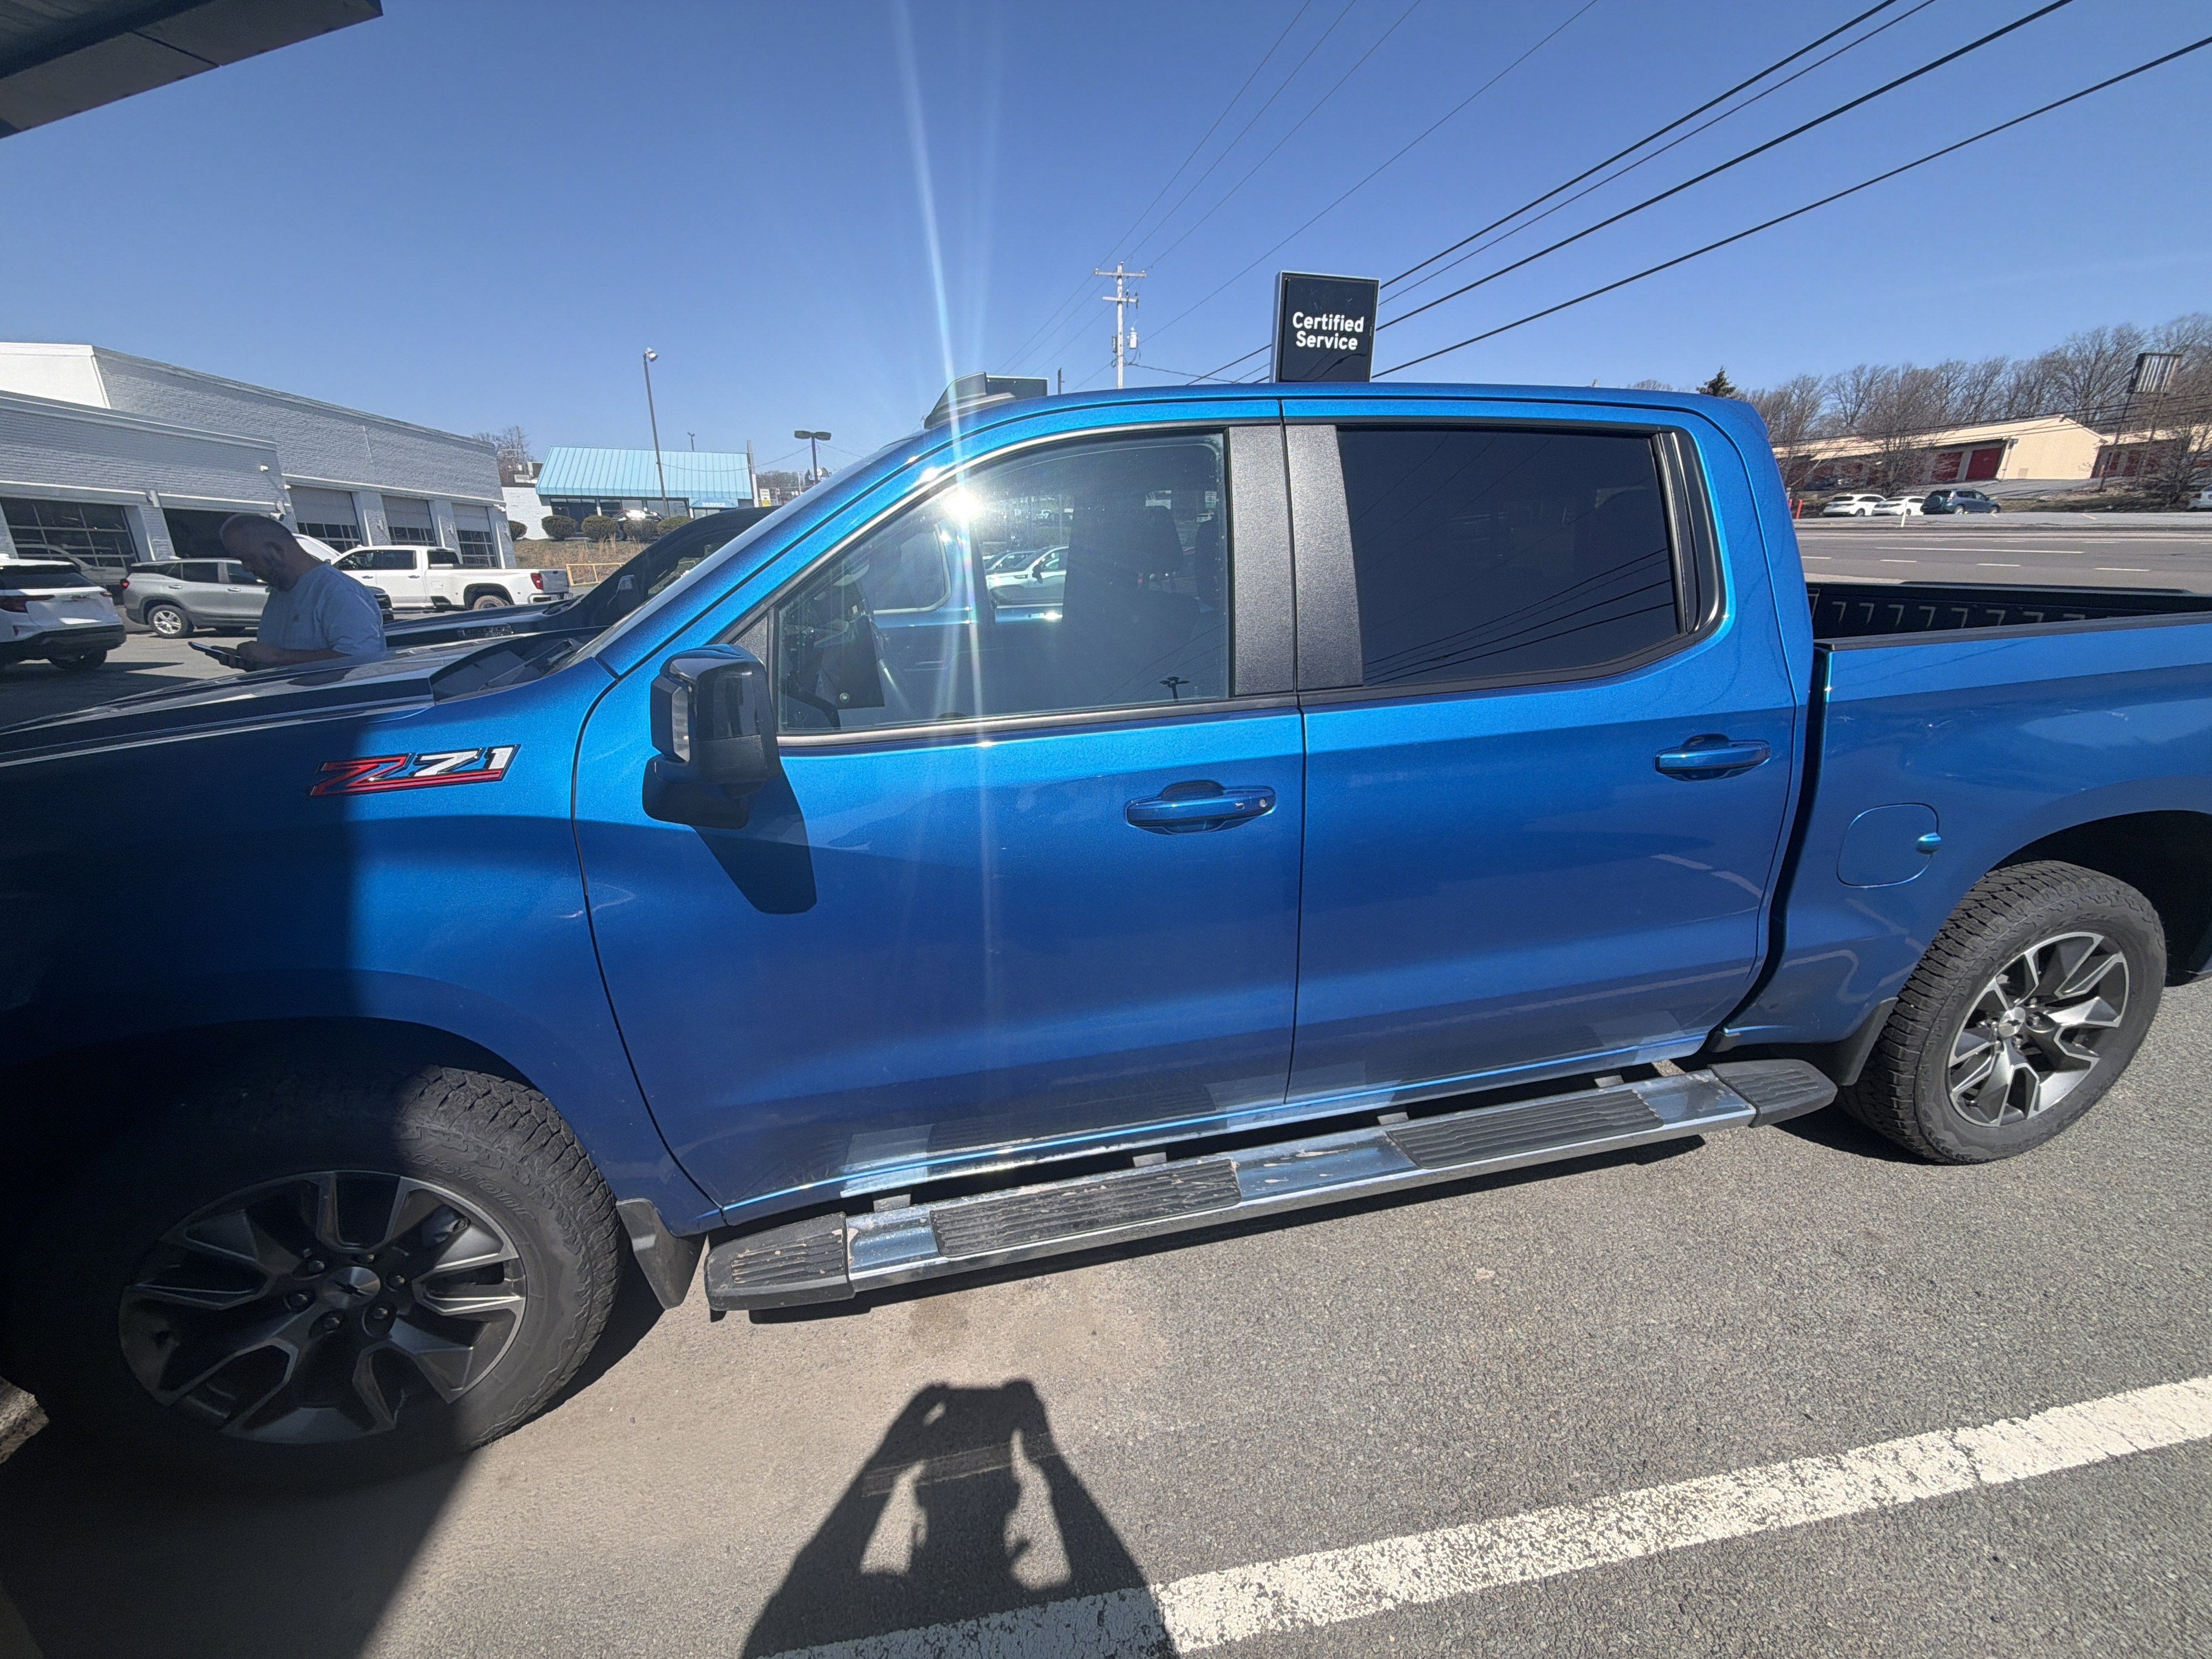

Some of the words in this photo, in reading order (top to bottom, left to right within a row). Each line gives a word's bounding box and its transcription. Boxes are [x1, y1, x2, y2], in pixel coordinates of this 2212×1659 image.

[1293, 312, 1364, 332] Certified
[1296, 330, 1358, 350] Service
[310, 744, 521, 796] Z71
